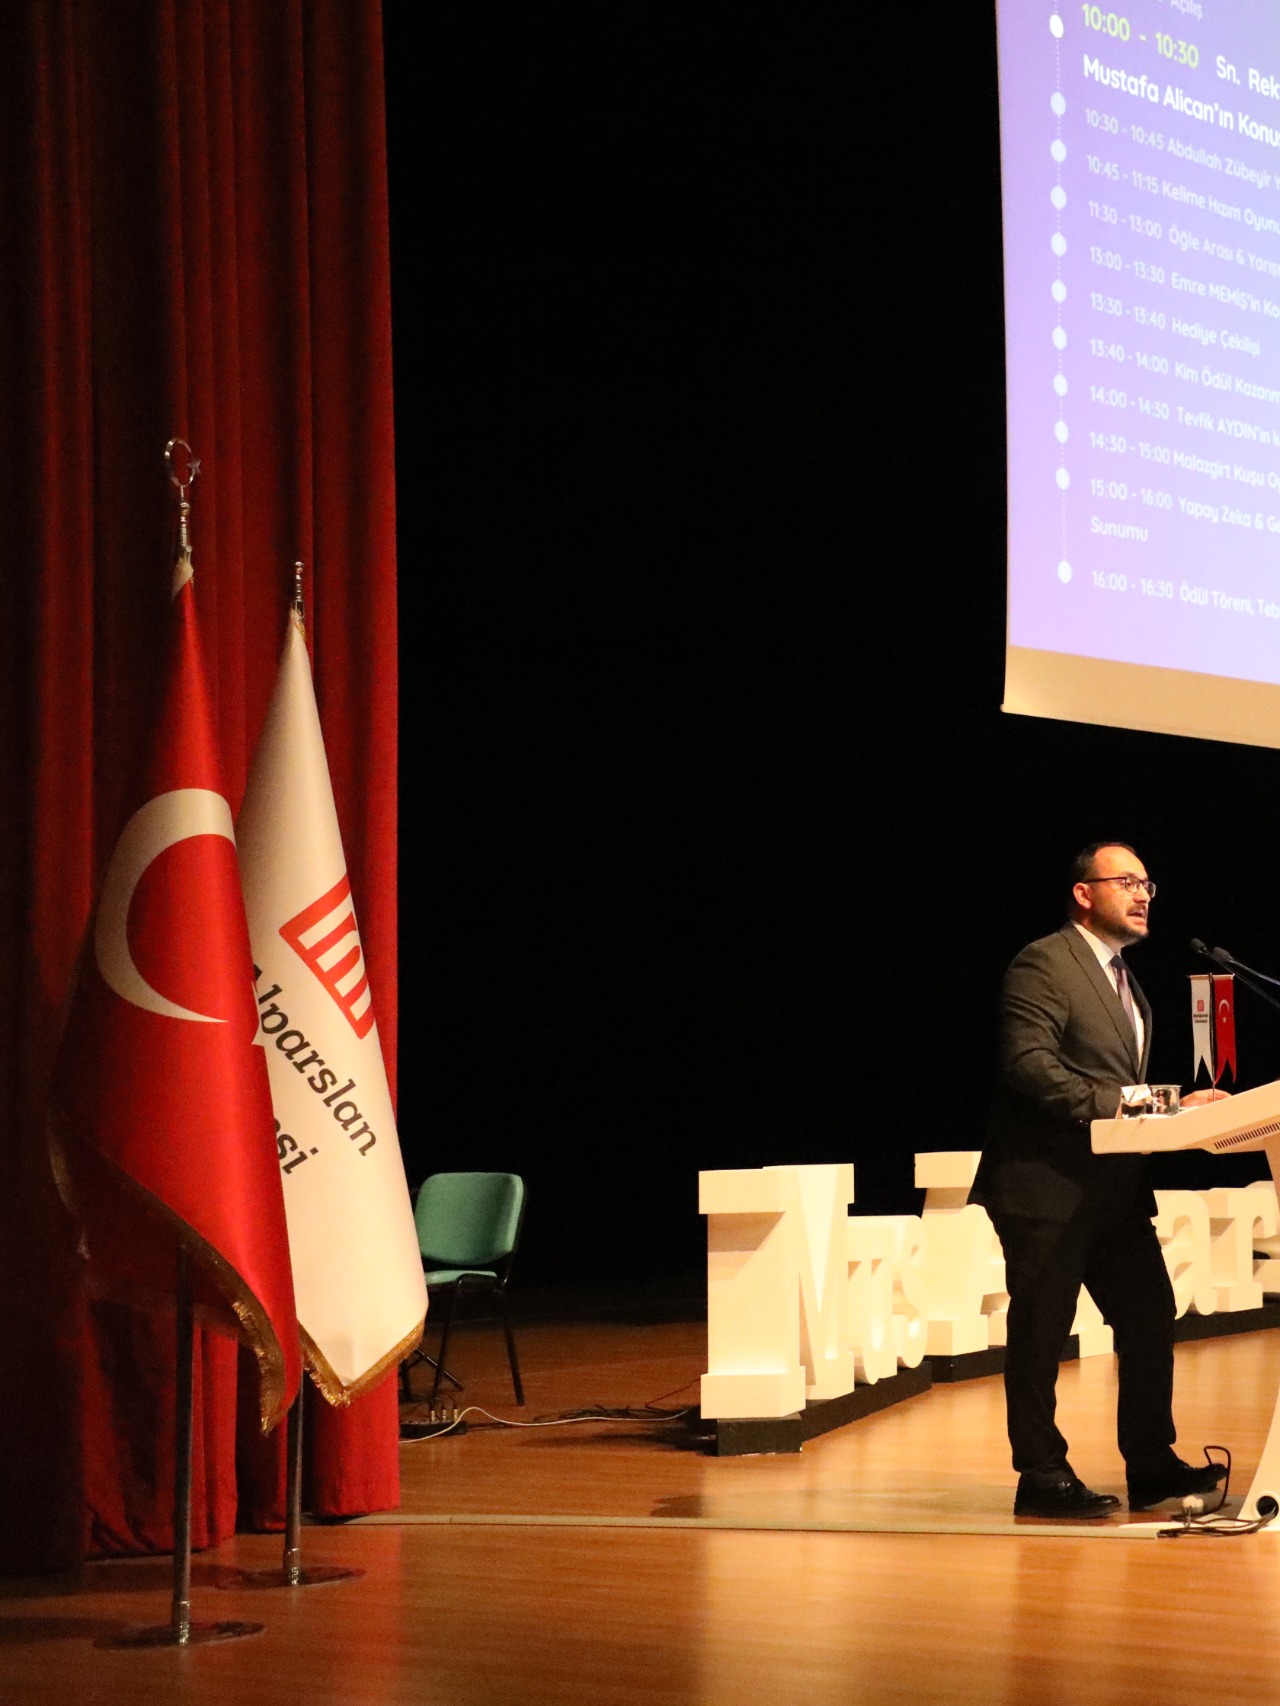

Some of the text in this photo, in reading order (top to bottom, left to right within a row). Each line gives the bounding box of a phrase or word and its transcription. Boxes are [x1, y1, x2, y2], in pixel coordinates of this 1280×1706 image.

[1082, 3, 1130, 41] 10:00
[1155, 32, 1199, 68] 10:30
[1216, 55, 1240, 85] Sn.
[1083, 54, 1159, 103] Mustafa
[1085, 108, 1119, 135] 10:30
[1130, 125, 1164, 150] 10:45
[1167, 138, 1222, 172] Abdullah
[1225, 157, 1272, 189] Zübeyir
[1087, 155, 1120, 181] 10:45
[1132, 171, 1159, 194] 11:15
[1162, 180, 1205, 209] Kelime
[1089, 201, 1117, 225] 11:30
[1129, 214, 1162, 239] 13:00
[1169, 224, 1200, 251] Öğle
[1203, 238, 1233, 262] Arası
[1236, 249, 1245, 265] &
[1090, 246, 1122, 271] 13:00
[1134, 260, 1165, 284] 13:30
[1171, 271, 1206, 296] Emre
[1090, 292, 1122, 316] 13:30
[1134, 306, 1166, 330] 13:40
[1172, 317, 1217, 346] Hediye
[1220, 330, 1261, 358] Çekilişi
[1090, 338, 1125, 362] 13:40
[1135, 351, 1169, 374] 14:00
[1175, 362, 1198, 383] Kim
[1201, 365, 1232, 391] Ödül
[1089, 385, 1127, 409] 14:00
[1138, 397, 1170, 420] 14:30
[1176, 406, 1214, 431] Tevfik
[1089, 431, 1127, 453] 14:30
[1139, 441, 1170, 465] 15:00
[1173, 450, 1231, 480] Malazgirt
[1234, 464, 1265, 487] Kuşu
[1090, 478, 1127, 500] 15:00
[1140, 488, 1172, 510] 16:00
[1178, 496, 1219, 524] Yapay
[1222, 505, 1251, 528] Zeka
[1254, 513, 1264, 530] &
[1090, 516, 1149, 542] Sunumu
[1092, 570, 1127, 592] 16:00
[1141, 578, 1174, 599] 16:30
[1180, 580, 1208, 605] Ödül
[1211, 590, 1254, 616] Töreni,
